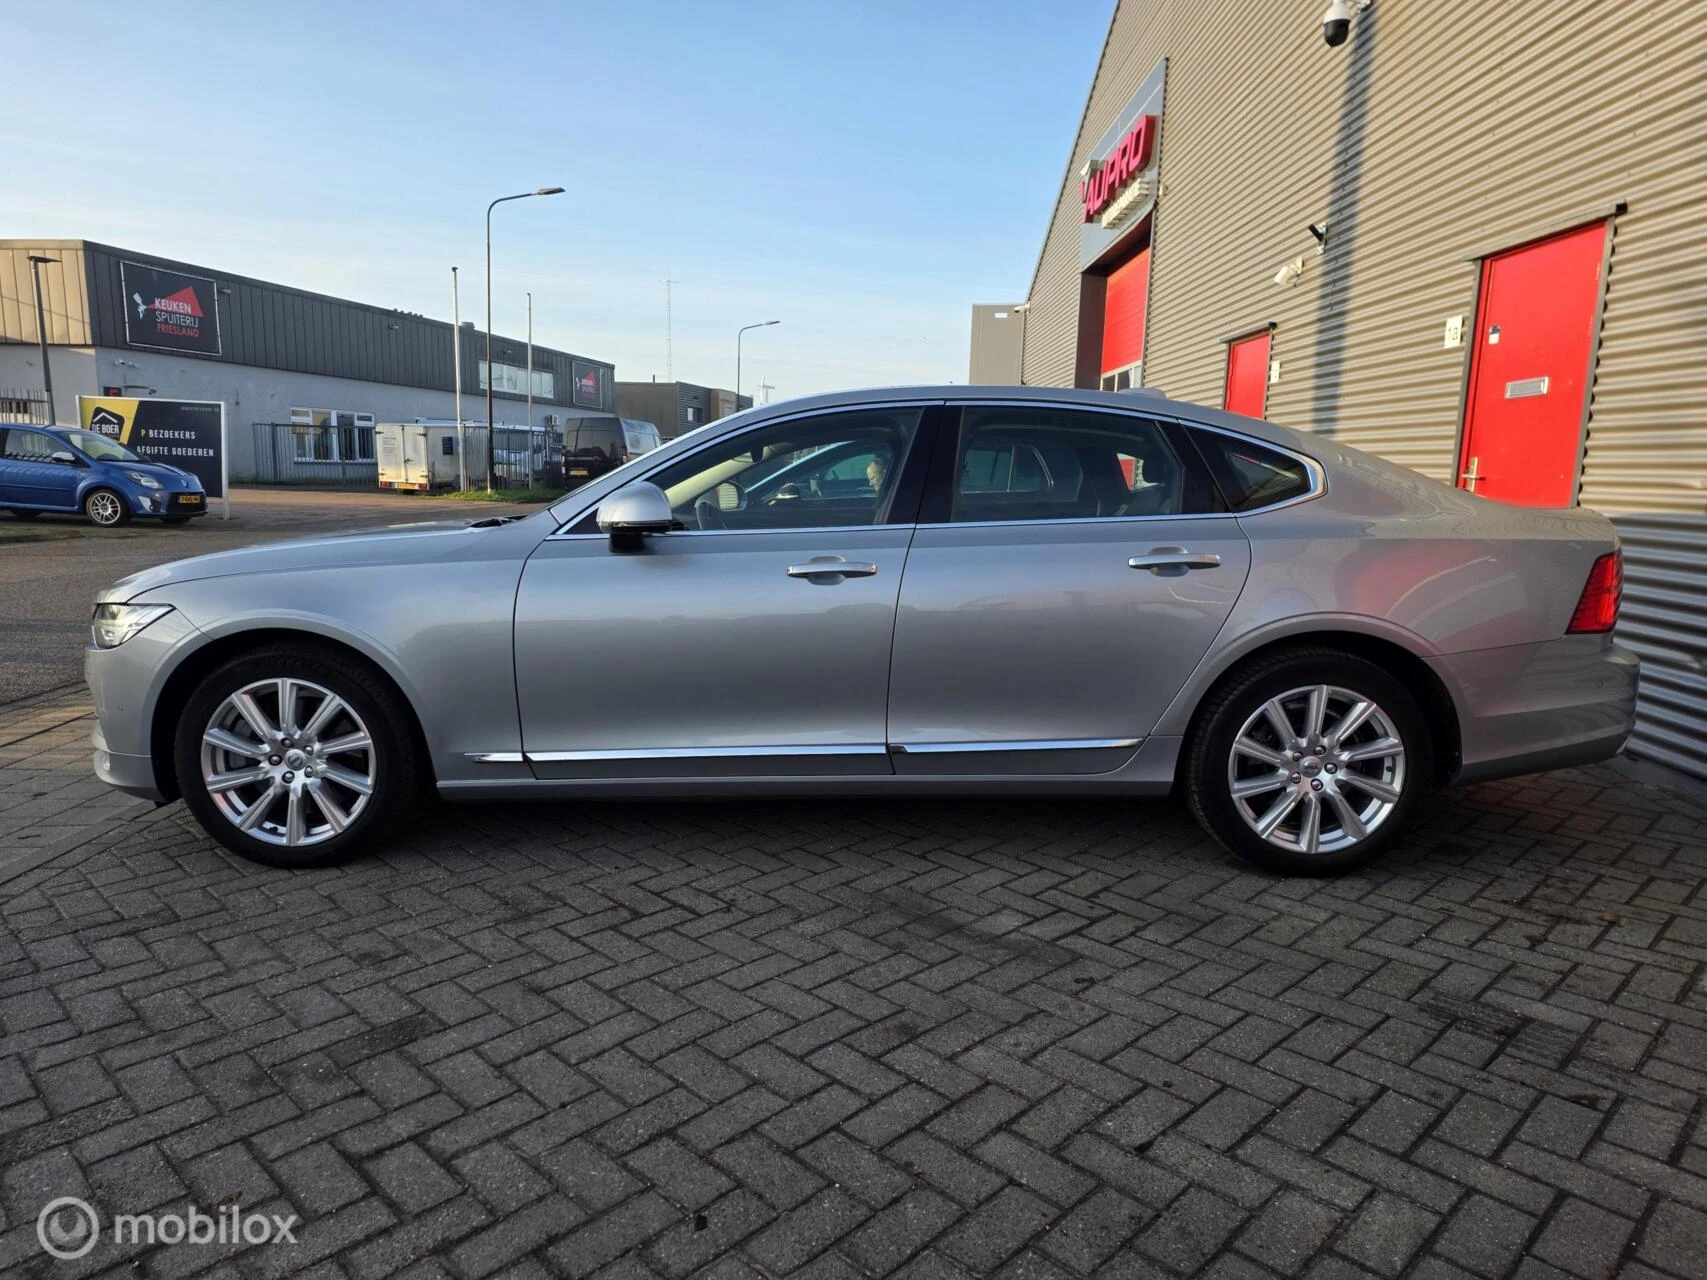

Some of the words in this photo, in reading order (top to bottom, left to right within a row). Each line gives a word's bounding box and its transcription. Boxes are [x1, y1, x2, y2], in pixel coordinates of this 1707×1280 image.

[155, 297, 191, 313] KEUKEN
[155, 310, 199, 328] SPUITERIJ
[156, 323, 199, 337] FRIESLAND
[101, 424, 119, 434] BOER
[148, 429, 196, 439] BEZOEKERS
[171, 446, 214, 457] GOEDEREN
